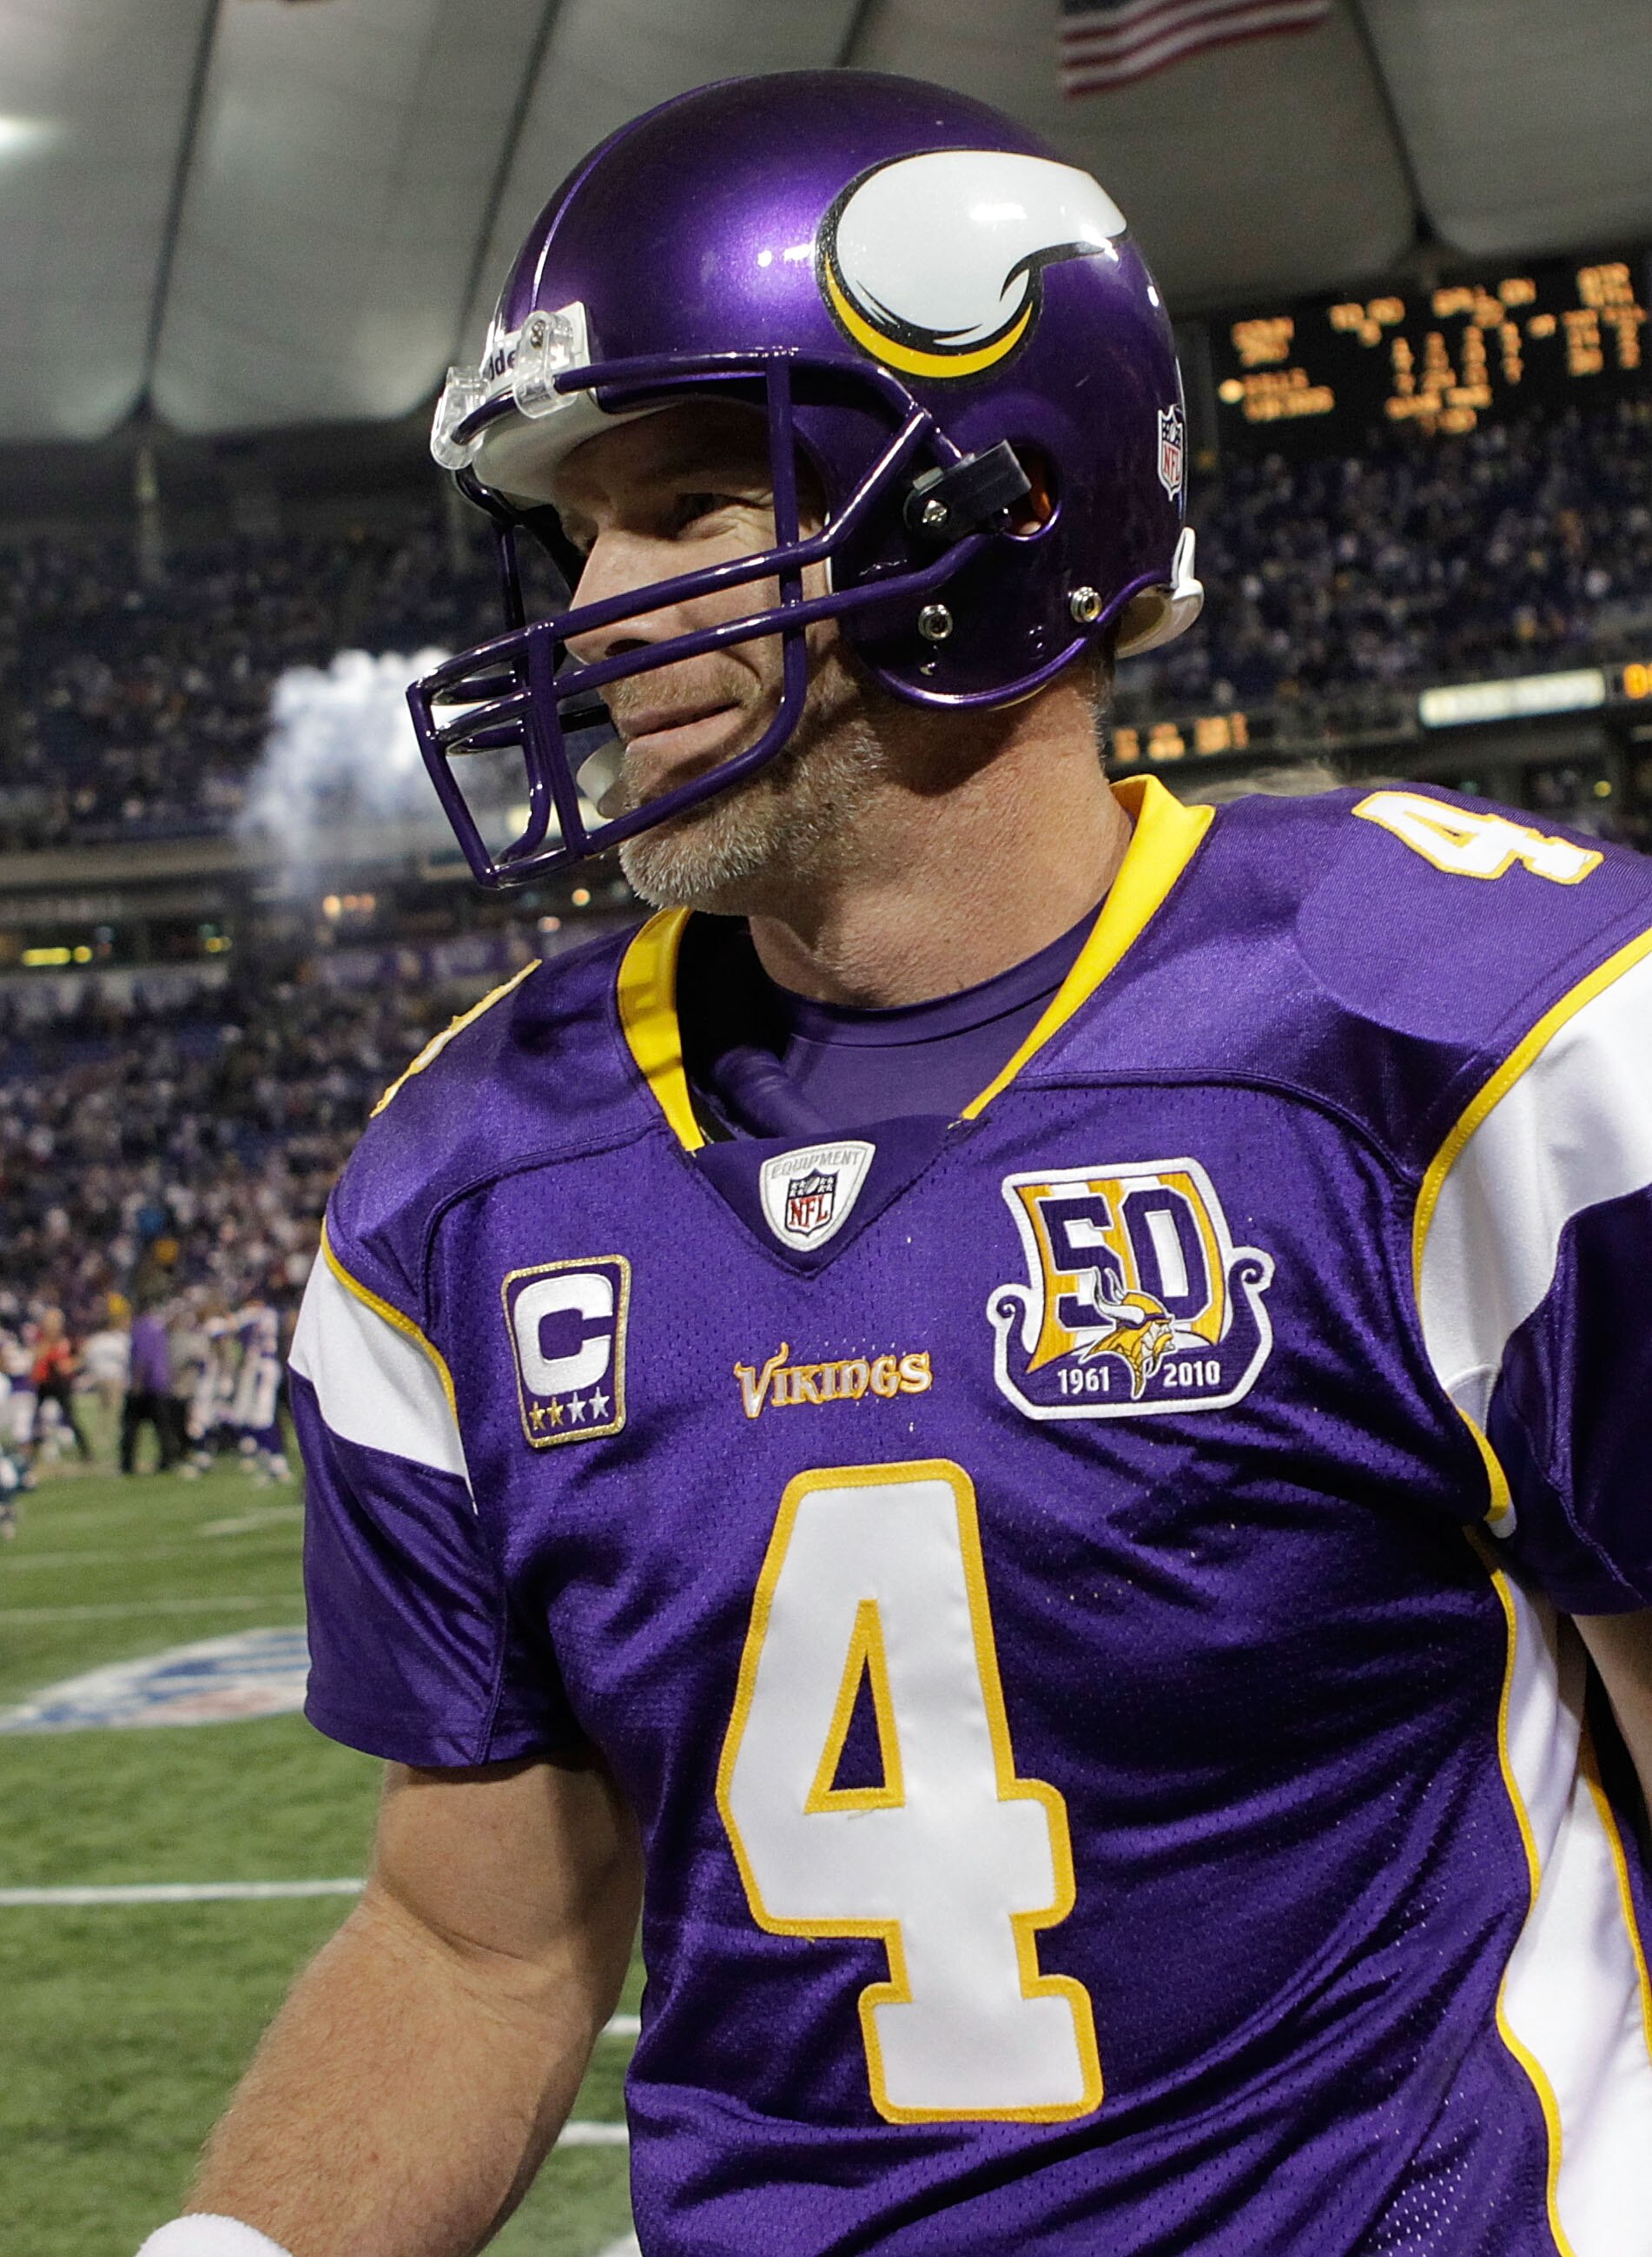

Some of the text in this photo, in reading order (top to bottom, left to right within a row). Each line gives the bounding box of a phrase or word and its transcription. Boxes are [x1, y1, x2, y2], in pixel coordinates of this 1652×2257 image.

[1351, 791, 1605, 885] 4
[771, 1150, 862, 1179] EQUIPMENT
[789, 1194, 829, 1228] NFL
[1036, 1186, 1213, 1330] 50
[514, 1274, 613, 1396] C
[1057, 1360, 1220, 1395] 1961 2010
[715, 1458, 1105, 2123] 4
